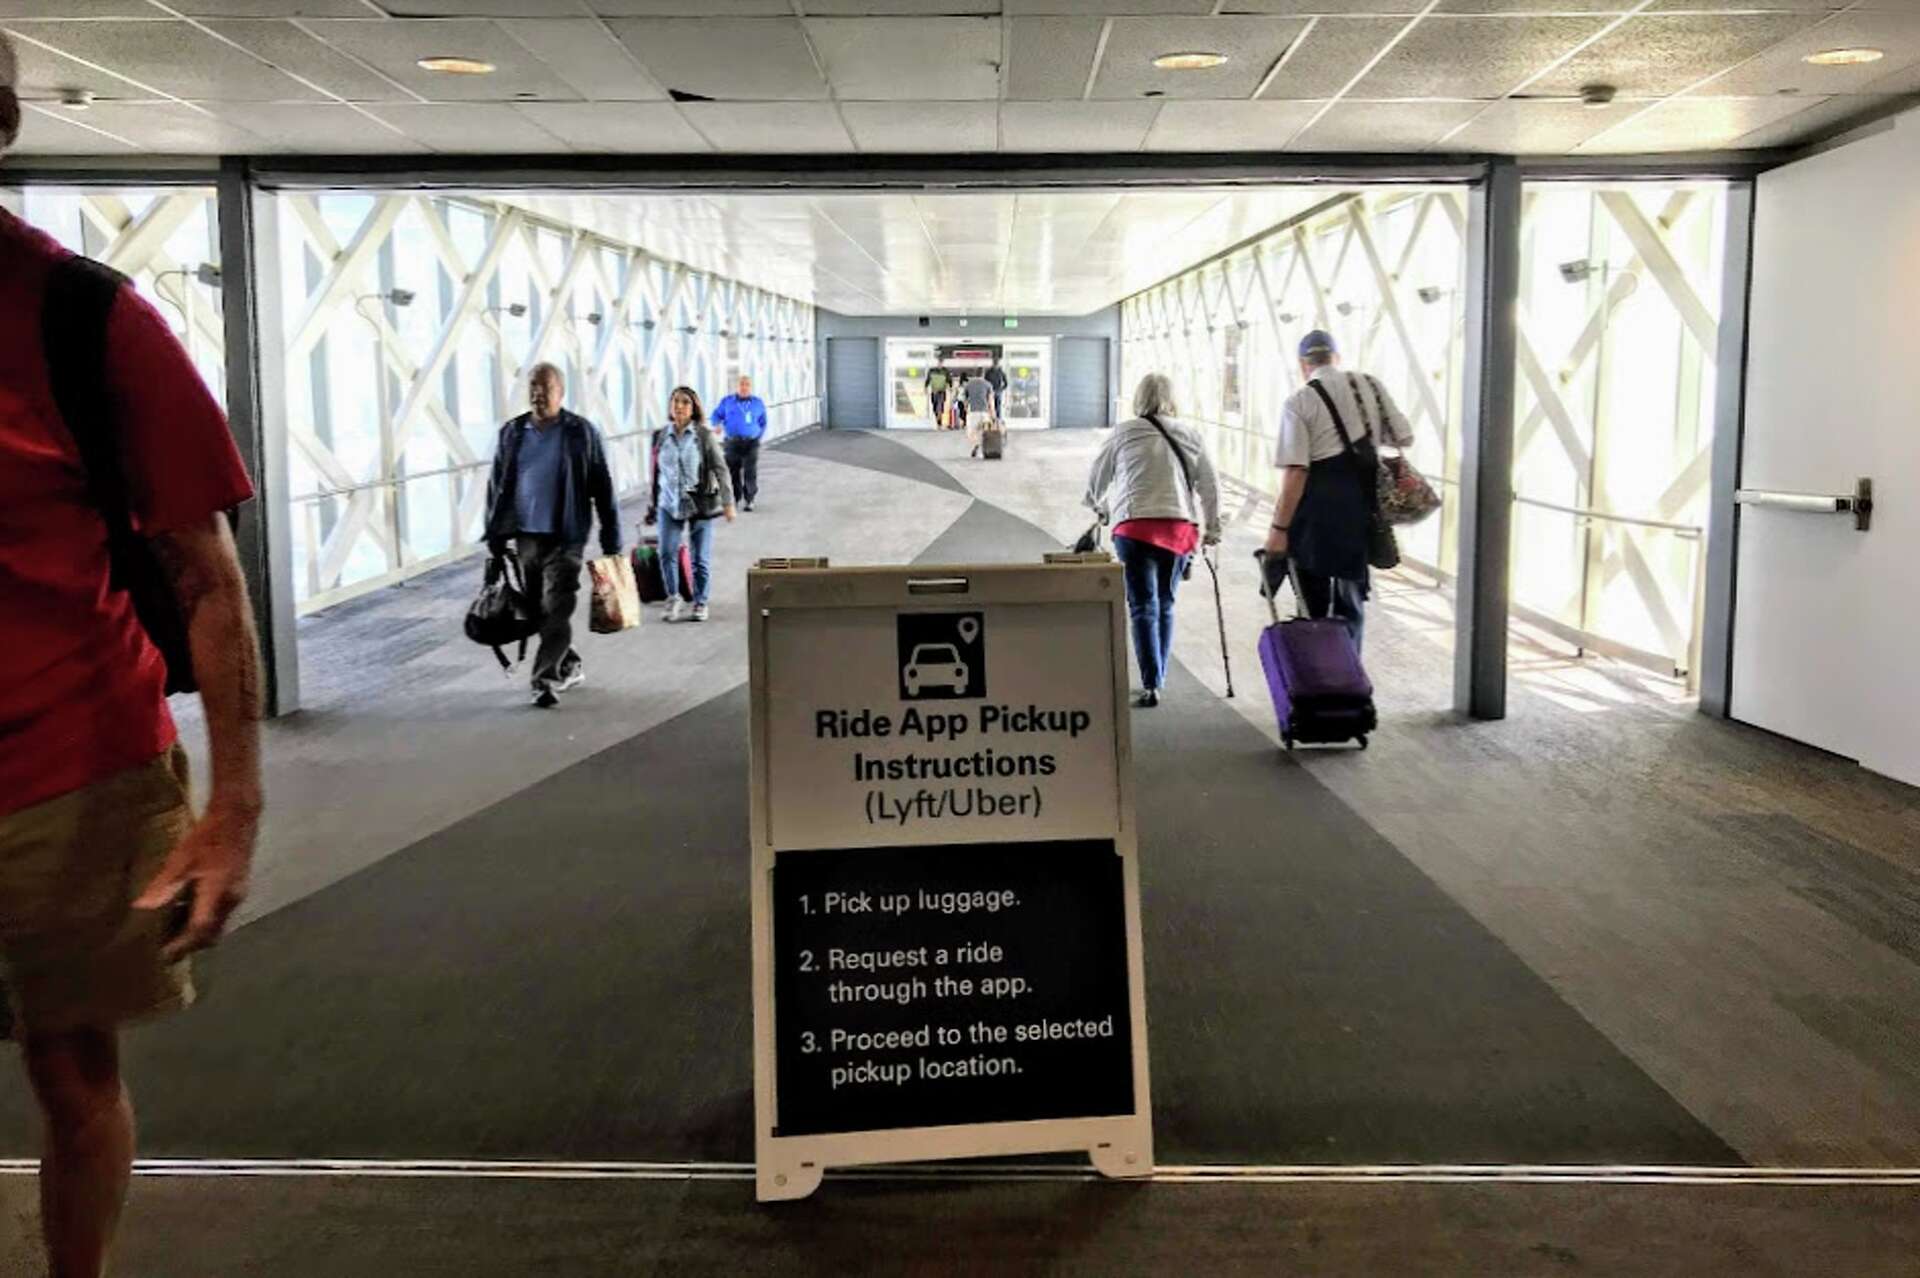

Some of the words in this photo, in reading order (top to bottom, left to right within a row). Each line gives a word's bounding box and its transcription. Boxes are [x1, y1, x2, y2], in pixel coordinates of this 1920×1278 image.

[816, 709, 891, 738] Ride
[899, 709, 968, 742] App
[980, 705, 1090, 737] Pickup
[855, 749, 1056, 781] Instructions
[866, 786, 1041, 825] (Lyft/Uber)
[800, 895, 816, 914] 1.
[825, 892, 872, 913] Pick
[880, 895, 910, 915] up
[919, 890, 1020, 913] luggage.
[800, 950, 820, 971] 2.
[829, 947, 927, 972] Request
[936, 949, 948, 964] a
[957, 942, 1002, 962] ride
[829, 978, 926, 1004] through
[934, 976, 973, 997] the
[981, 978, 1032, 998] app.
[802, 1032, 821, 1053] 3.
[832, 1025, 929, 1051] Proceed
[937, 1027, 961, 1045] to
[969, 1022, 1007, 1043] the
[1015, 1016, 1113, 1041] selected
[832, 1060, 911, 1089] pickup
[920, 1054, 1022, 1078] location.
